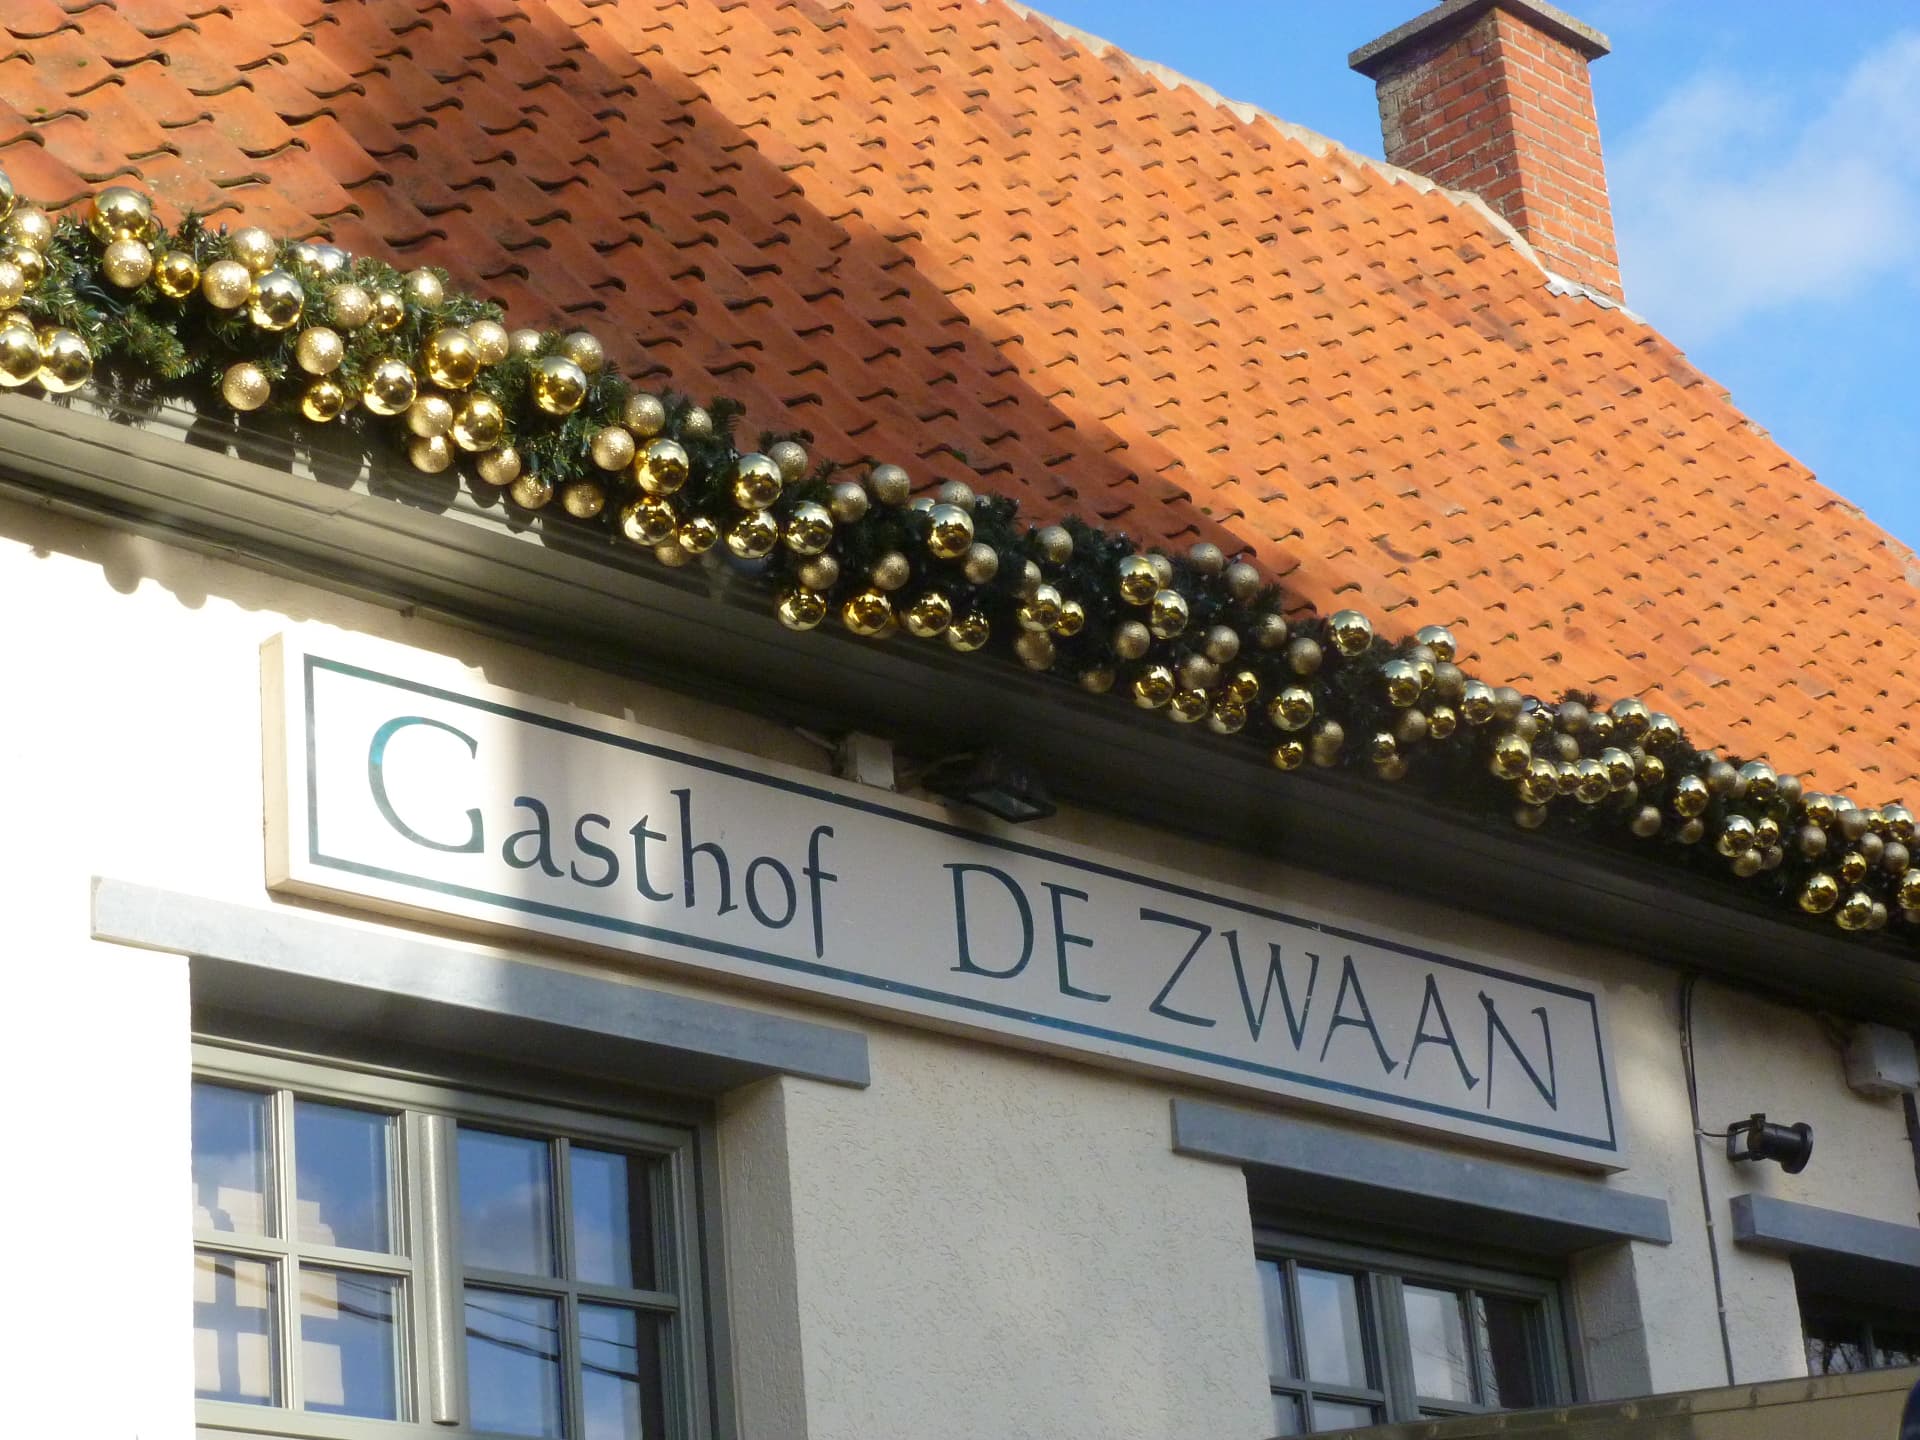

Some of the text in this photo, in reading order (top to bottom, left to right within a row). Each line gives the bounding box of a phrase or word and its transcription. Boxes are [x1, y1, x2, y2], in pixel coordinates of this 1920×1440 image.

[368, 715, 1557, 1112] Gasthof DE ZWAAN
